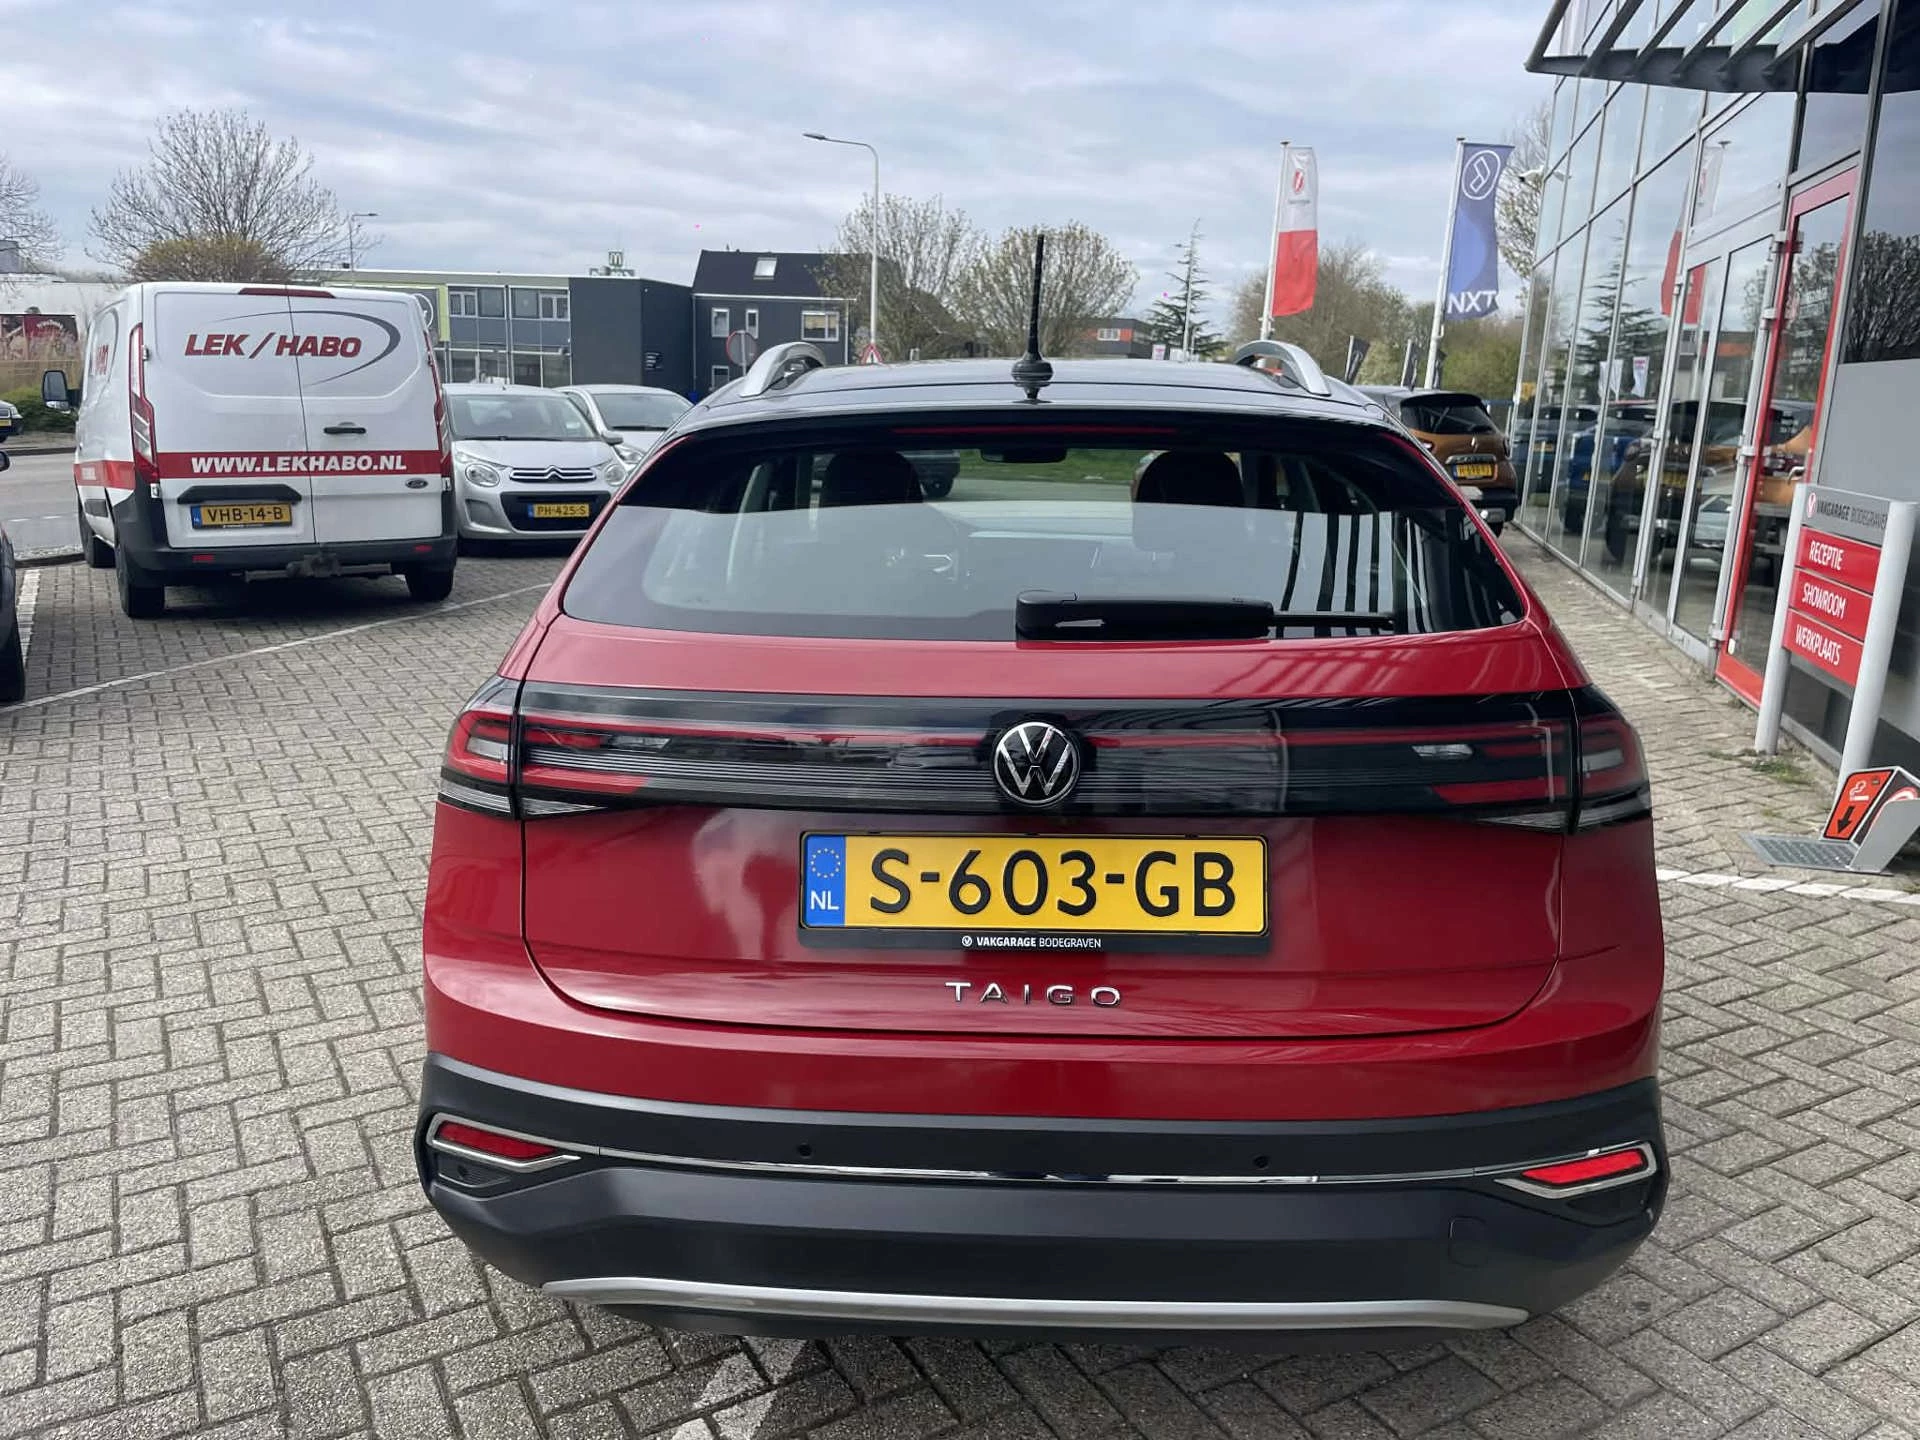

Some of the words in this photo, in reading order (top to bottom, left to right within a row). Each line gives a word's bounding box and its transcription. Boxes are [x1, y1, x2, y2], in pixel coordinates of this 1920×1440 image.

[191, 456, 407, 473] WWW.LEKHABO.NL
[207, 506, 284, 522] VHB-14-B
[1809, 540, 1844, 570] RECEPTIE
[1802, 583, 1846, 619] SHOWROOM
[1796, 624, 1841, 666] WERKPLAATS
[870, 848, 1236, 917] S-603-GB
[810, 890, 840, 910] NL
[976, 937, 1036, 947] VAKGARAGE
[1039, 938, 1101, 948] BODEGRAVEN
[945, 982, 1121, 1006] TAIGO
